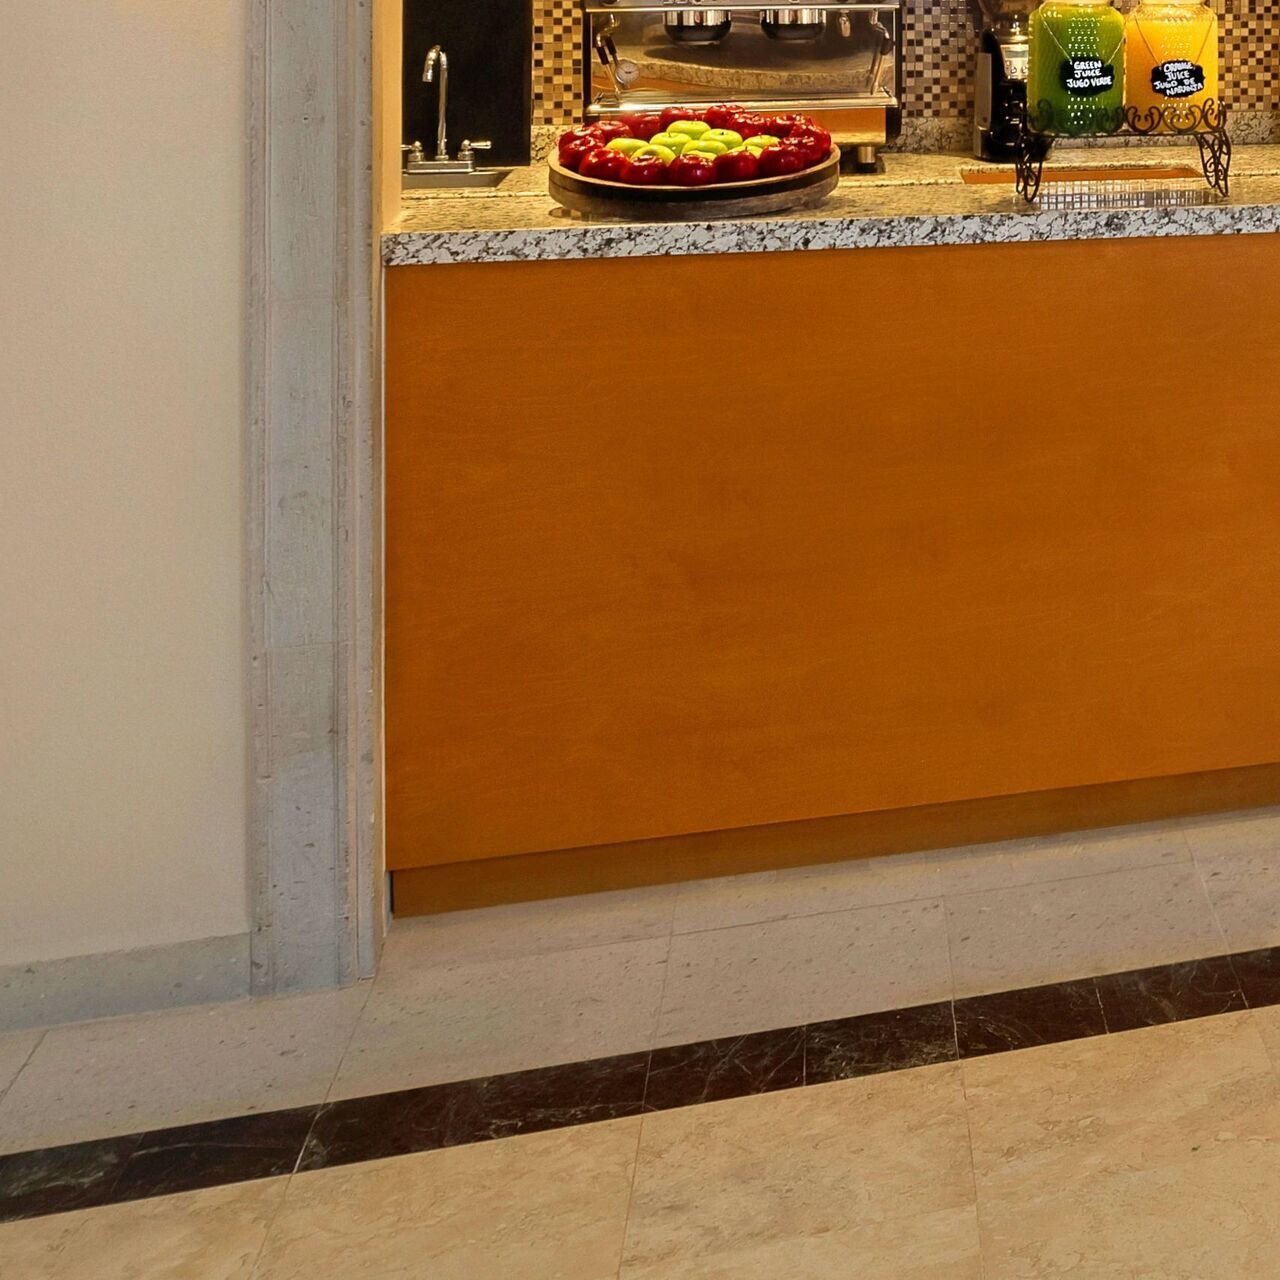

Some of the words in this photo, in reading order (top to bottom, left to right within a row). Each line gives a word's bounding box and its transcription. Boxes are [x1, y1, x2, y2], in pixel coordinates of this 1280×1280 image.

[1074, 61, 1102, 70] GREEN
[1074, 69, 1102, 78] JUICE
[1165, 71, 1190, 81] JUICE
[1066, 79, 1089, 88] JUGO
